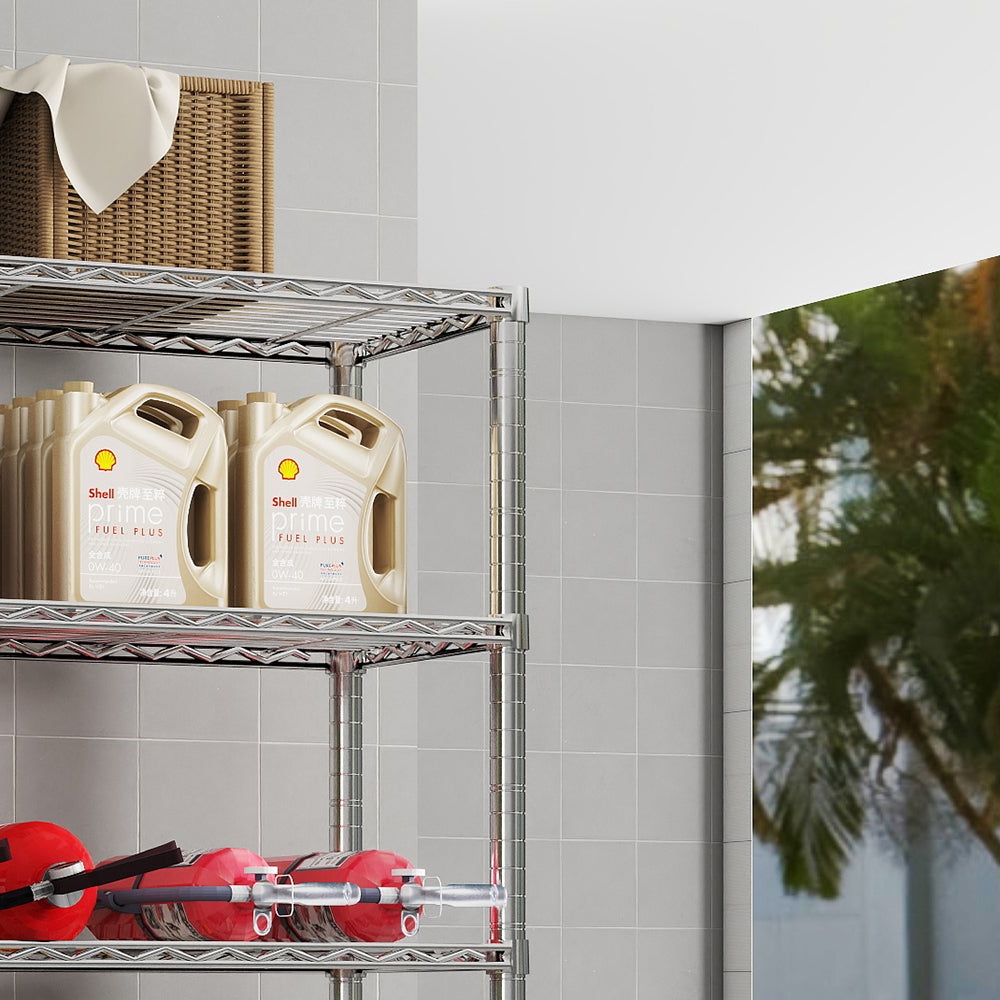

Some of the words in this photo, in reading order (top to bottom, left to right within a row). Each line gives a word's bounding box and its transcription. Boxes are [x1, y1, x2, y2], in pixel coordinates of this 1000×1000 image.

[88, 487, 115, 500] Shell
[272, 496, 298, 508] Shell
[88, 503, 164, 534] prime
[95, 525, 125, 535] FUEL
[134, 527, 164, 537] PLUS
[271, 511, 345, 542] prime
[278, 533, 308, 543] FUEL
[316, 535, 345, 545] PLUS
